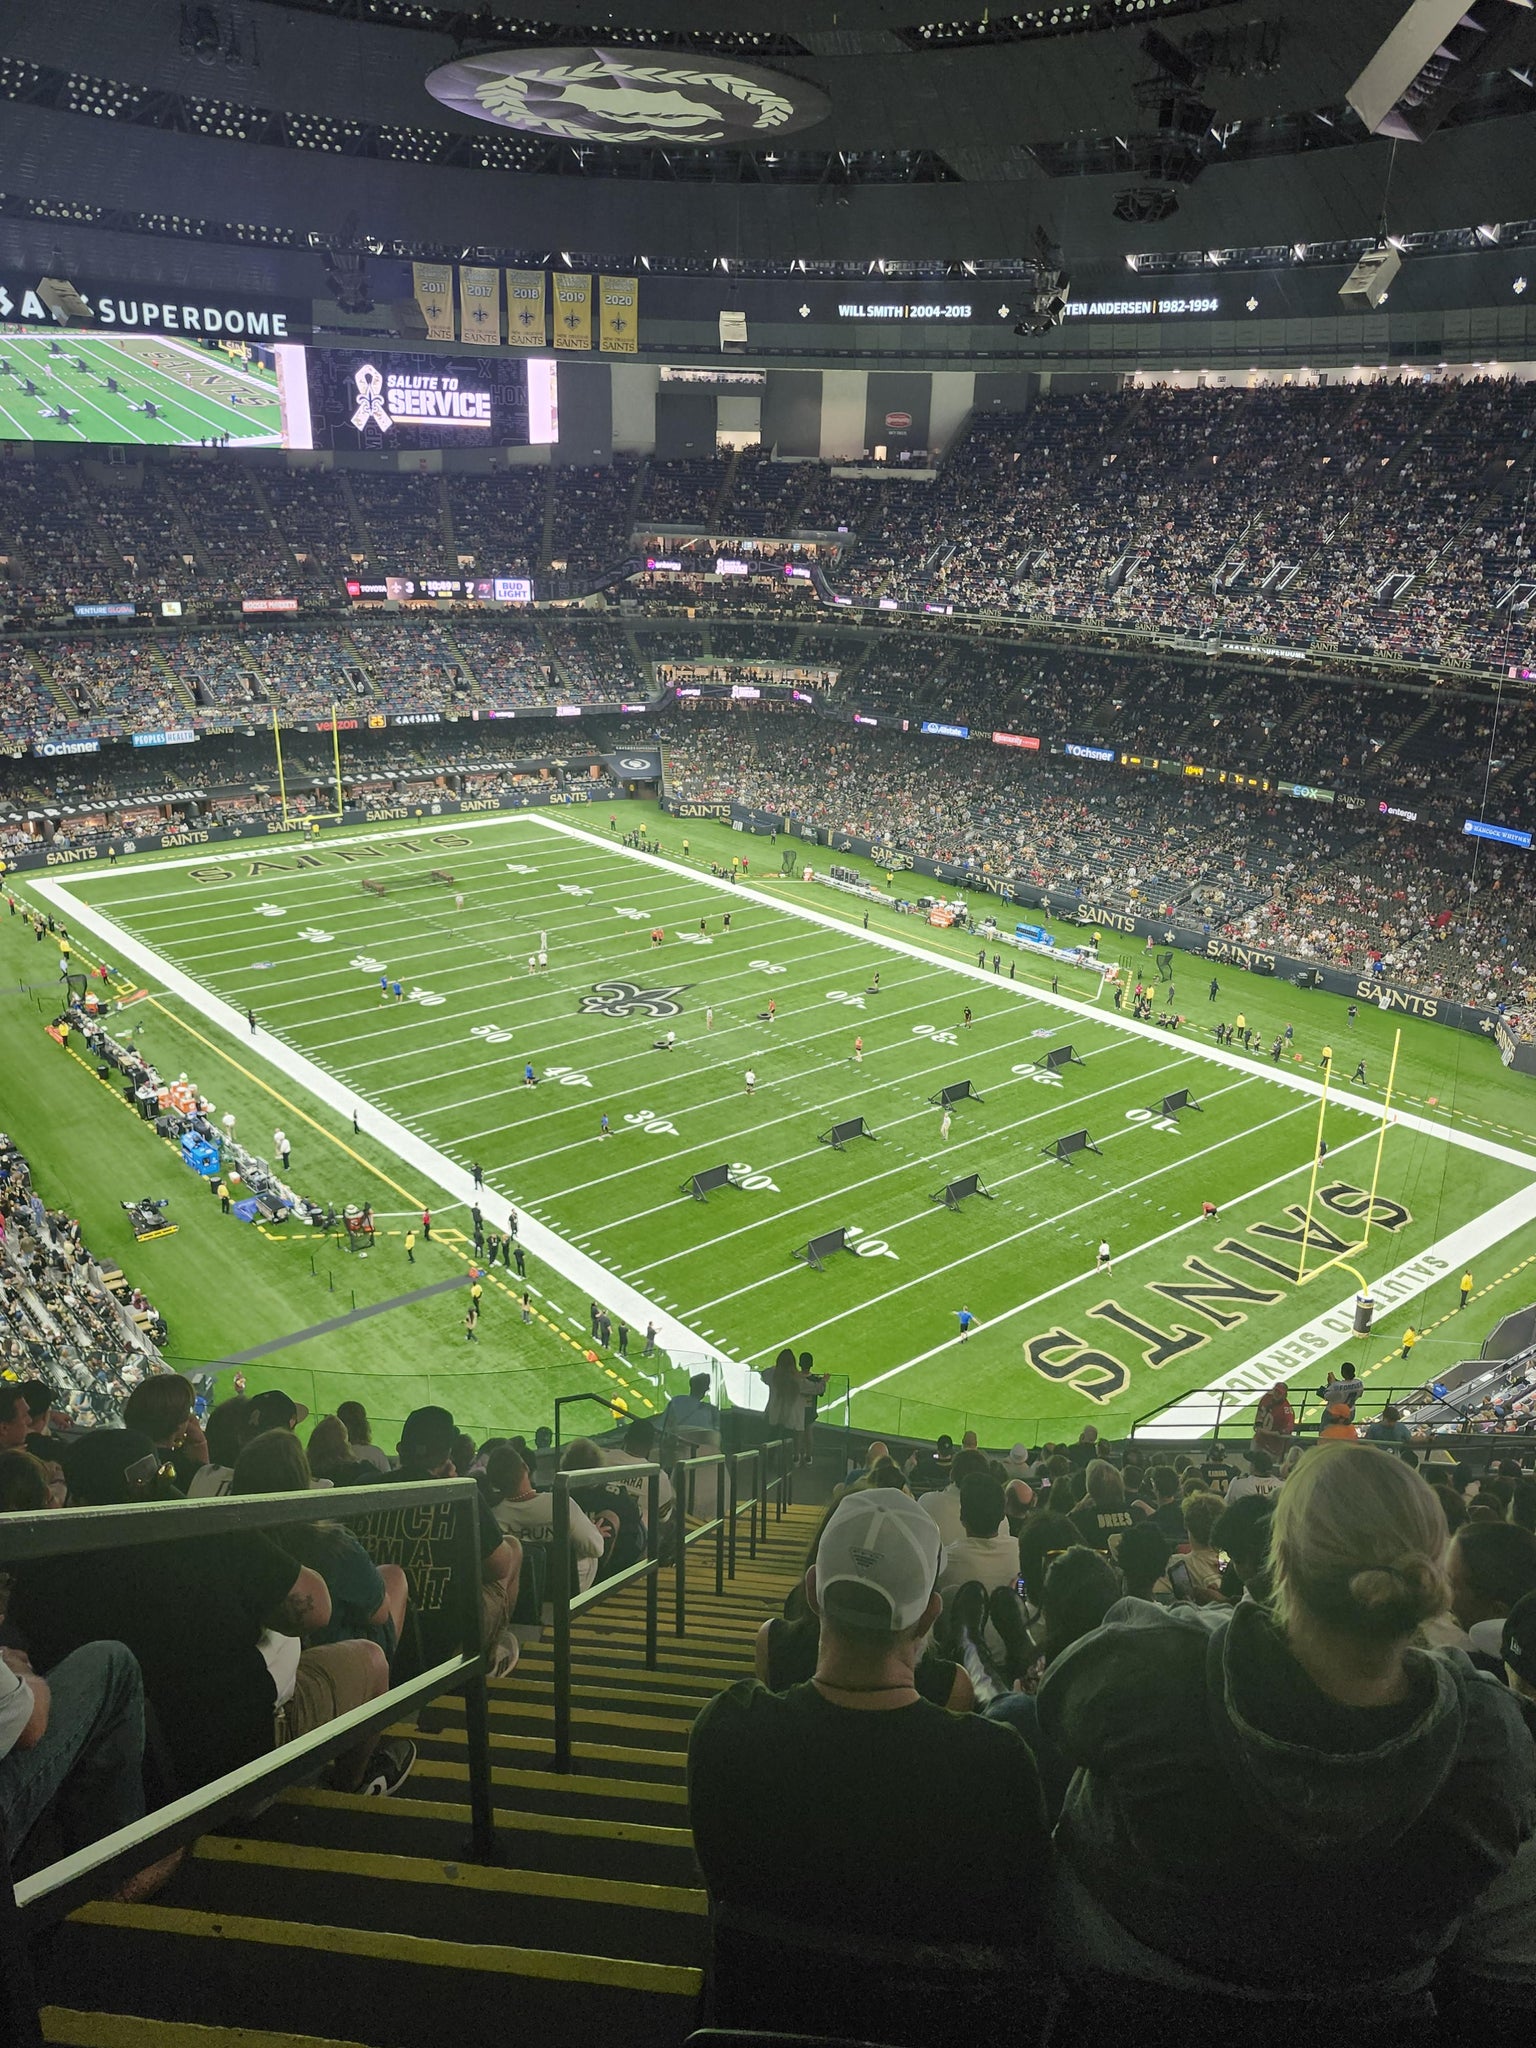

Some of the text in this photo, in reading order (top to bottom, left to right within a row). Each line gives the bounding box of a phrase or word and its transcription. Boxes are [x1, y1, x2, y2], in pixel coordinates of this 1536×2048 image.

[421, 282, 446, 293] 2011
[467, 286, 492, 297] 2017
[513, 288, 540, 299] 2018
[560, 292, 585, 302] 2019
[605, 294, 633, 306] 2020
[838, 304, 972, 318] WILL SMITH 2004-2013
[1063, 299, 1218, 316] TEN ANDERSEN 1982-1994
[99, 298, 289, 337] SUPERDOME
[464, 332, 497, 343] SAINTS
[511, 335, 544, 345] SAINTS
[557, 338, 590, 349] SAINTS
[602, 341, 635, 351] SAINTS
[387, 375, 459, 390] SALUTE TO
[387, 389, 491, 419] SERVICE
[360, 585, 388, 593] TOYOTA
[405, 581, 415, 594] 3
[465, 582, 474, 594] 7
[502, 582, 523, 590] BUD
[499, 590, 528, 598] LIGHT
[75, 607, 108, 615] VENTURE
[979, 608, 1002, 616] SAINTS
[1030, 613, 1053, 621] SAINTS
[1081, 618, 1106, 627] SAINTS
[1135, 622, 1160, 632] SAINTS
[1250, 635, 1277, 645] SAINTS
[1310, 642, 1339, 652] SAINTS
[1373, 650, 1404, 660] SAINTS
[1440, 657, 1472, 669] SAINTS
[315, 719, 358, 732] verzon
[370, 716, 385, 727] 25
[395, 714, 440, 725] CAESARS
[134, 731, 194, 744] PEOPLES HEALTH
[205, 726, 234, 736] SAINTS
[938, 726, 962, 736] Allstate
[43, 741, 98, 756] Ochsner
[1074, 745, 1113, 762] Ochsner
[411, 763, 517, 777] SUPERDOME
[550, 790, 588, 803] SAINTS
[1293, 785, 1318, 799] COX
[78, 789, 208, 812] SUPERDOME
[460, 799, 500, 812] SAINTS
[1337, 794, 1366, 807] SAINTS
[366, 807, 408, 822] SAINTS
[679, 804, 731, 817] SAINTS
[1388, 807, 1418, 821] entergy
[161, 831, 209, 848] SAINTS
[1473, 825, 1531, 844] HANCOCK WHITNEY
[47, 847, 98, 865] SAINTS
[188, 834, 473, 883] SAINTS
[1078, 903, 1136, 932] SAINTS
[1206, 940, 1276, 971] SAINTS
[350, 955, 388, 973] 30
[748, 960, 787, 975] 50
[407, 986, 446, 1006] 40
[1357, 980, 1438, 1018] SAINTS
[470, 1023, 513, 1043] 50
[912, 1024, 957, 1044] 30
[543, 1066, 588, 1086] 40
[624, 1110, 674, 1134] 30
[1370, 1255, 1450, 1312] SALUTE
[1022, 1179, 1414, 1405] SAINTS
[1208, 1331, 1330, 1407] SERVICE
